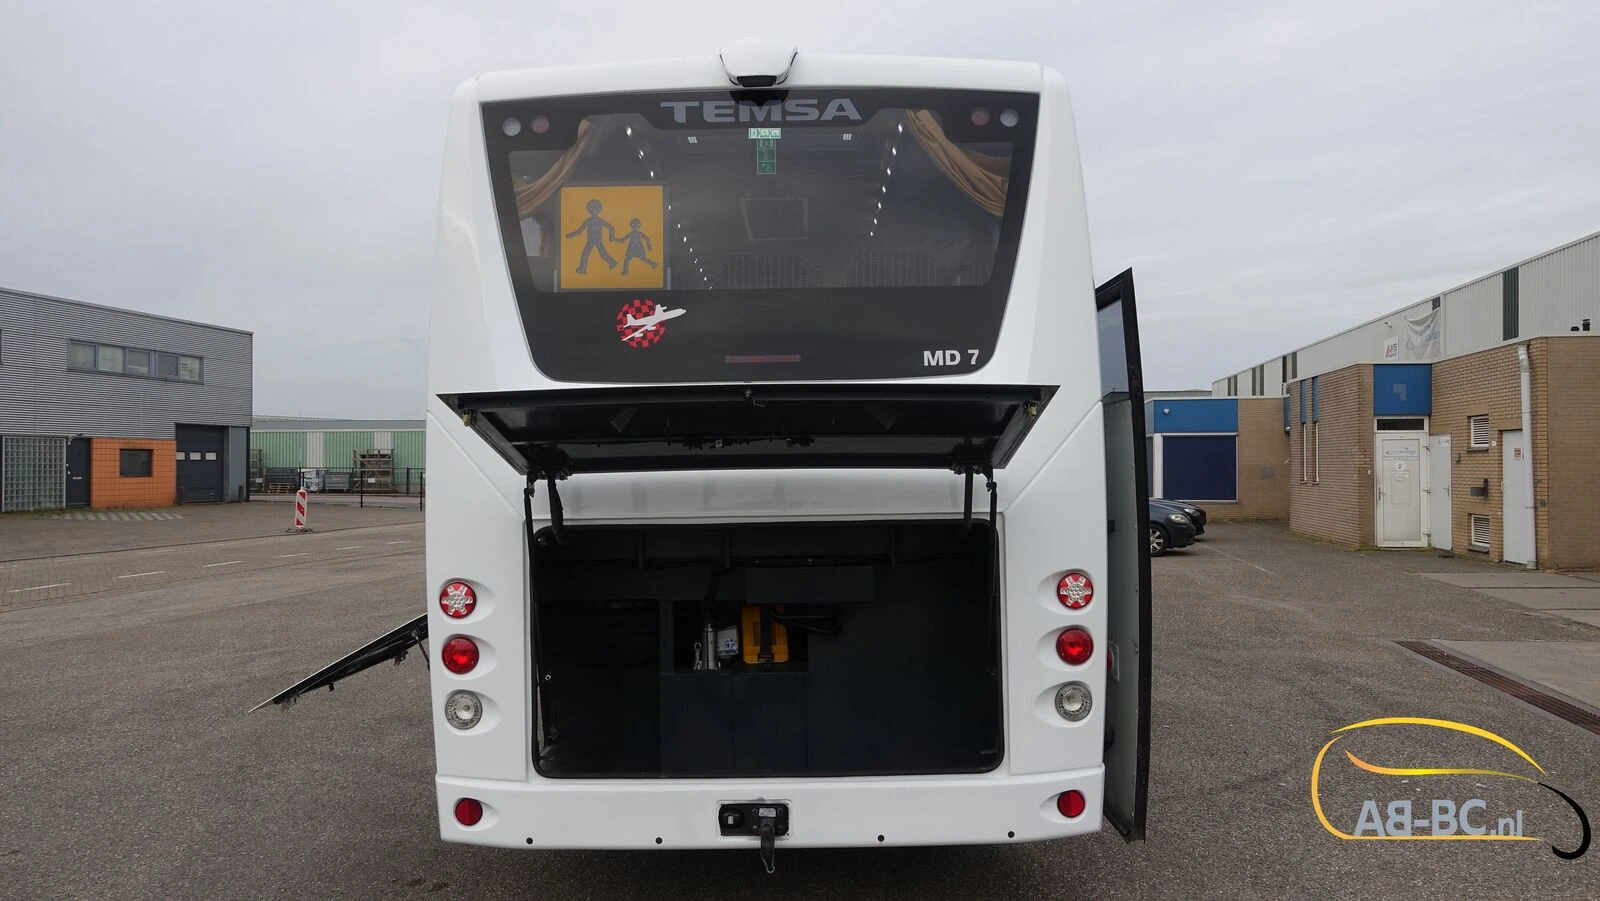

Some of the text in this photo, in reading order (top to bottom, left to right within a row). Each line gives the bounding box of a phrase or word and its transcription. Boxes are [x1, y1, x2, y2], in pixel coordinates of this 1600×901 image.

[660, 98, 862, 124] TEMSA
[923, 349, 980, 367] MD 7
